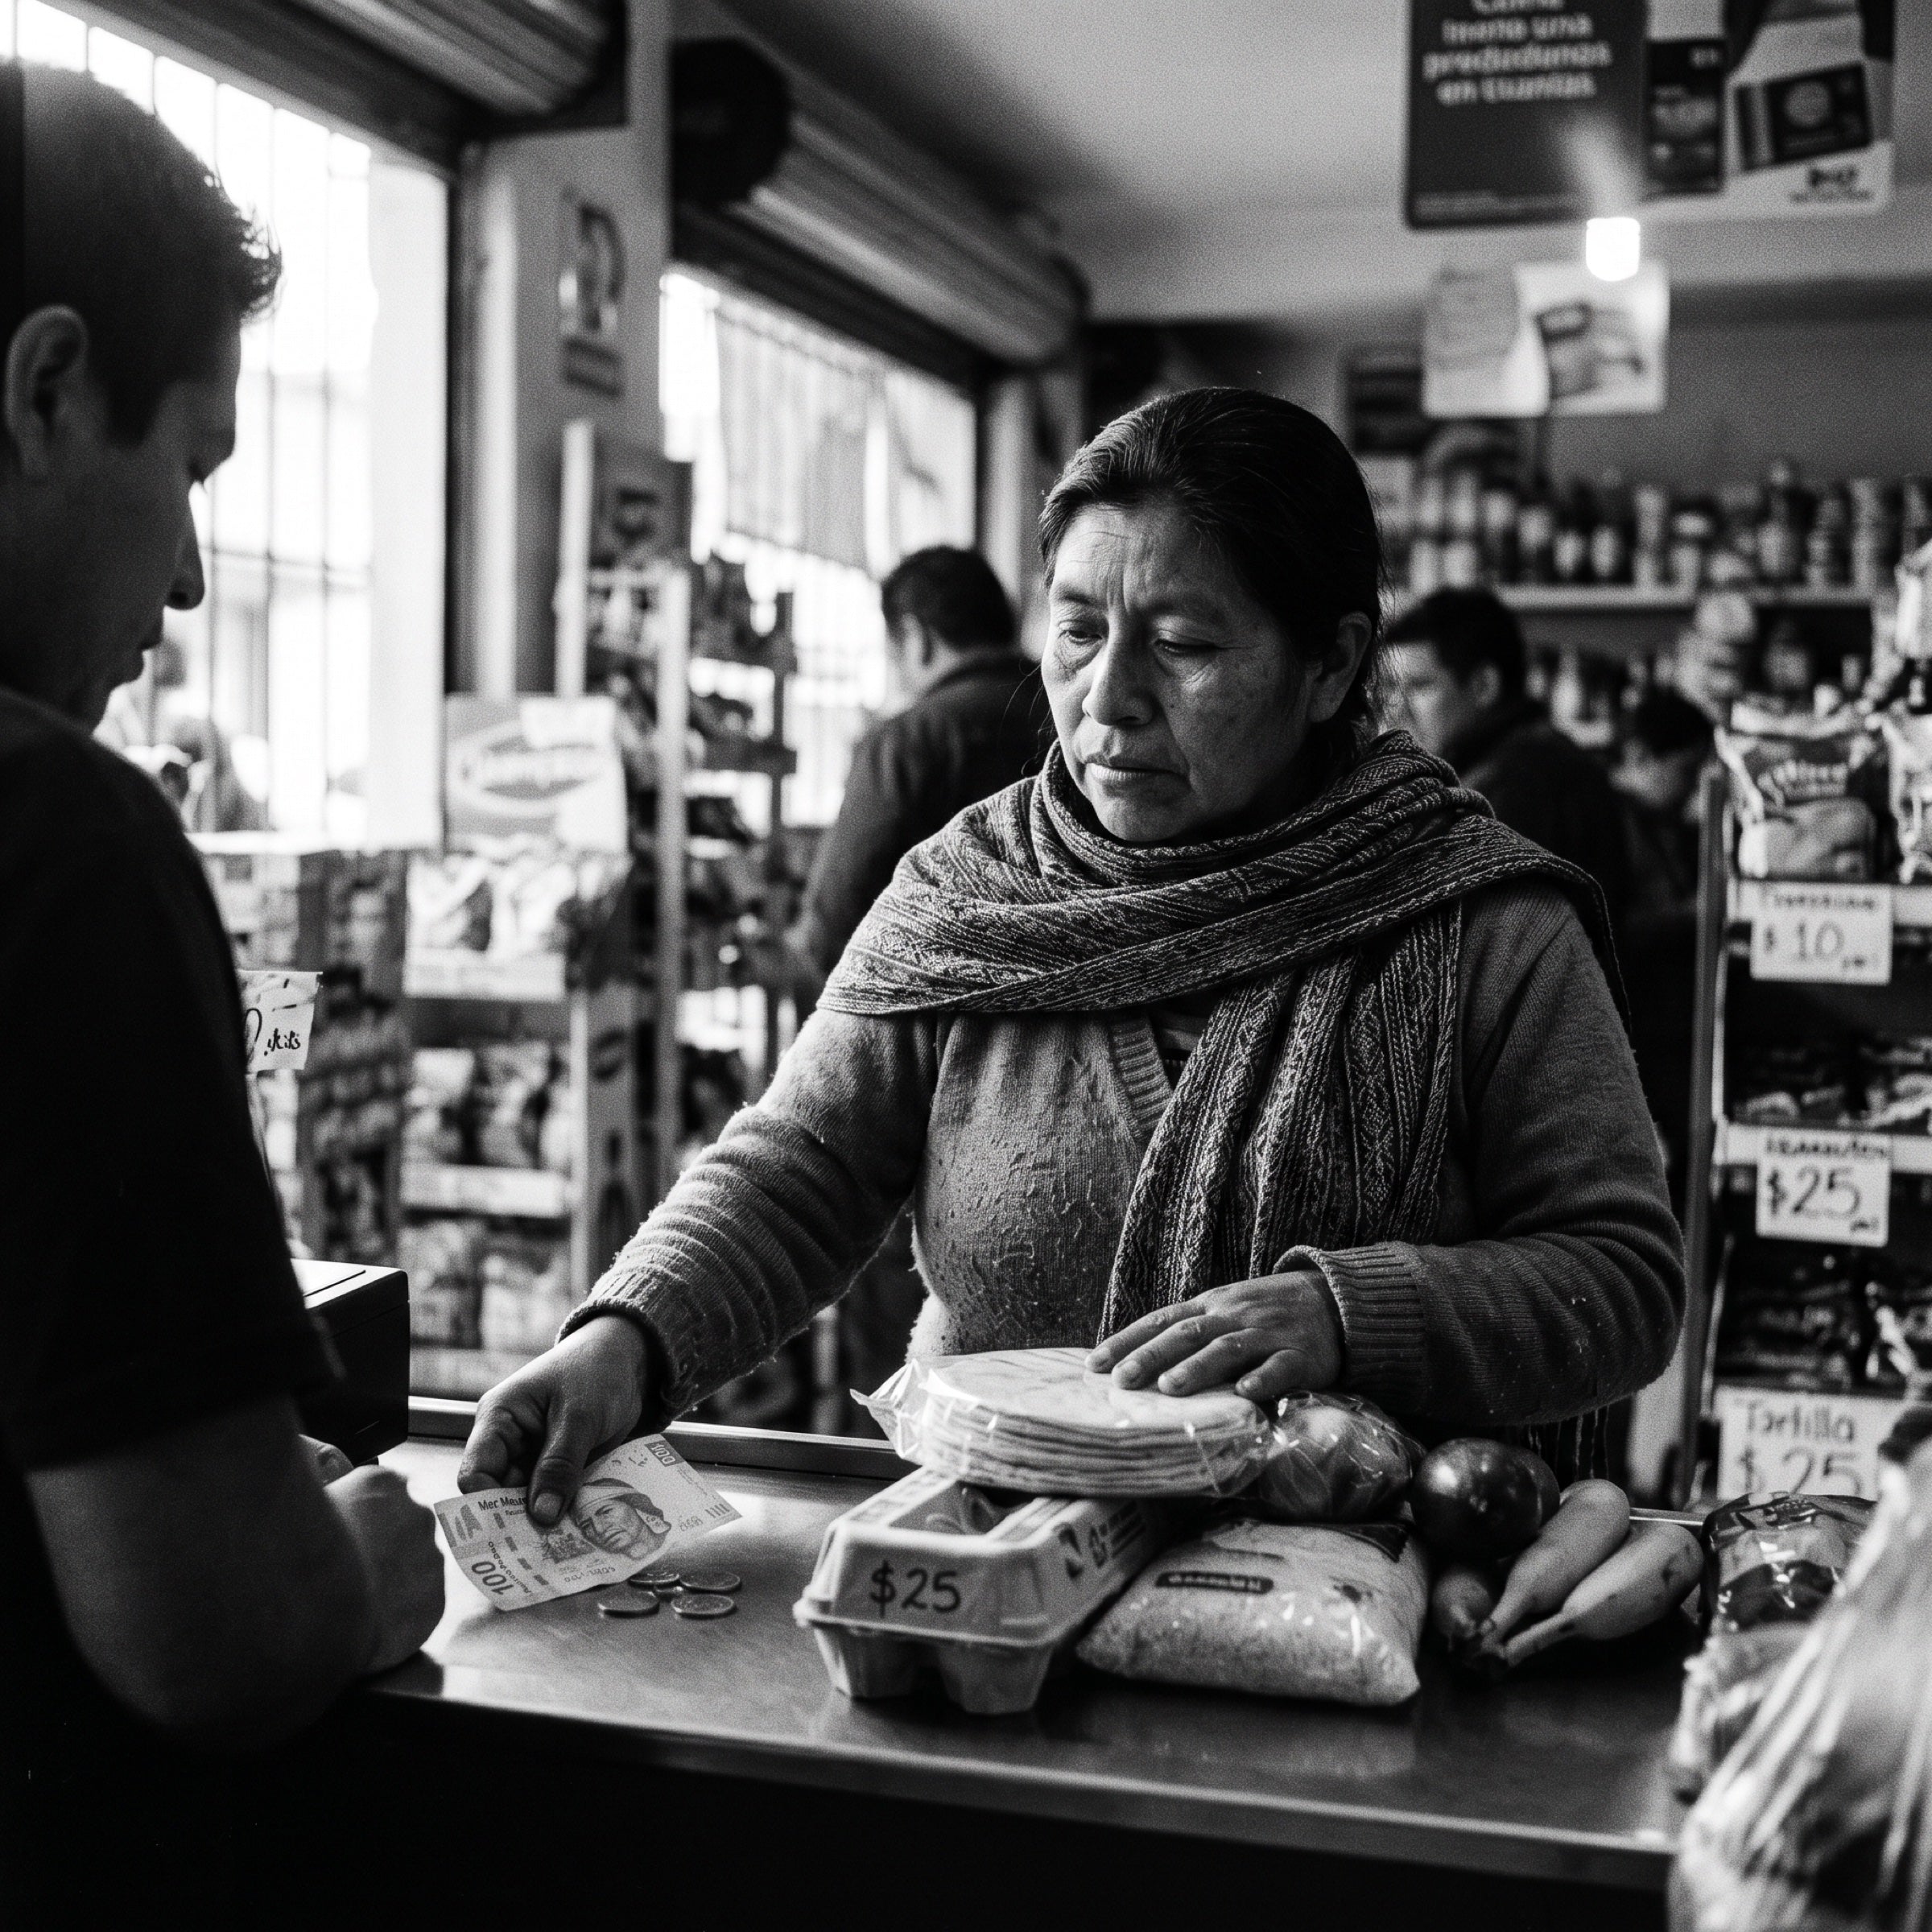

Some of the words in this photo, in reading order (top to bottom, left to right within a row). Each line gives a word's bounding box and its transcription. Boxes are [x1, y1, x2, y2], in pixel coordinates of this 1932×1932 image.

[1767, 1166, 1862, 1218] $25
[471, 1560, 514, 1596] 100
[869, 1560, 962, 1620] $25
